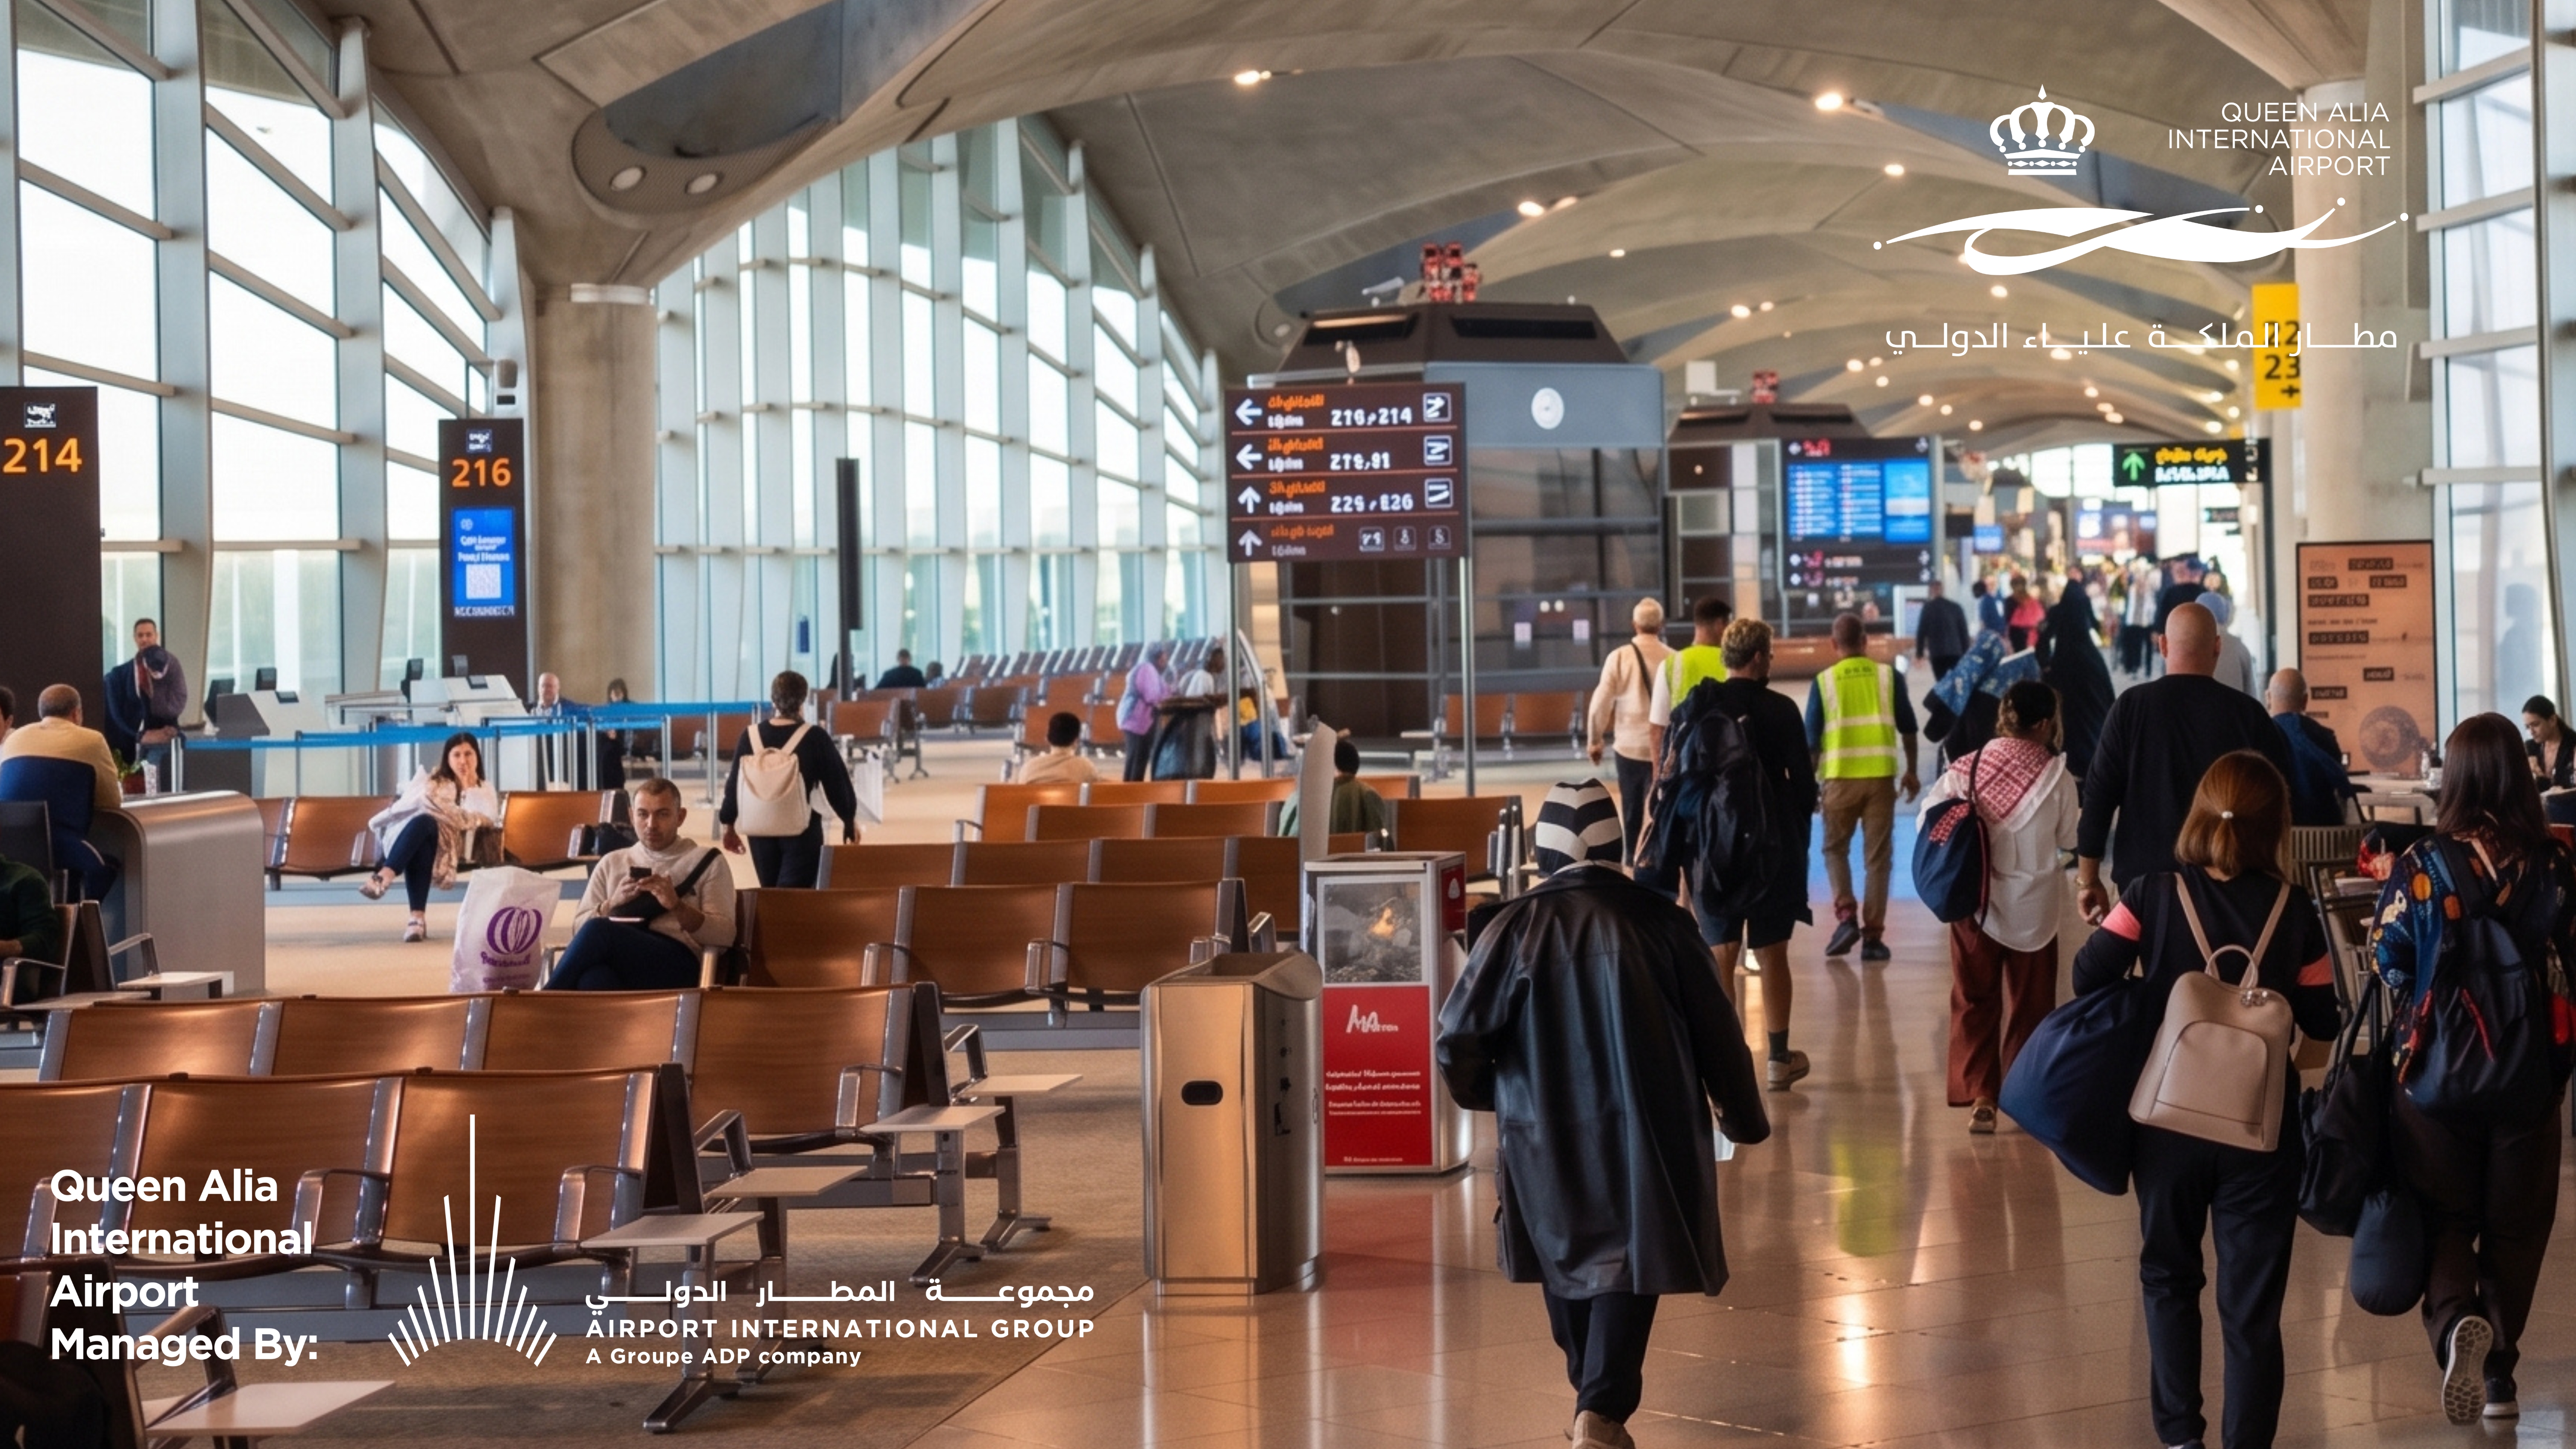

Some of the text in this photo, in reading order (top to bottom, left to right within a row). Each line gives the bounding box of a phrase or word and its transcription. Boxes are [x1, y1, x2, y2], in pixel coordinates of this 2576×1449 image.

[2265, 354, 2300, 380] 23
[3, 437, 82, 473] 214
[452, 458, 511, 487] 216
